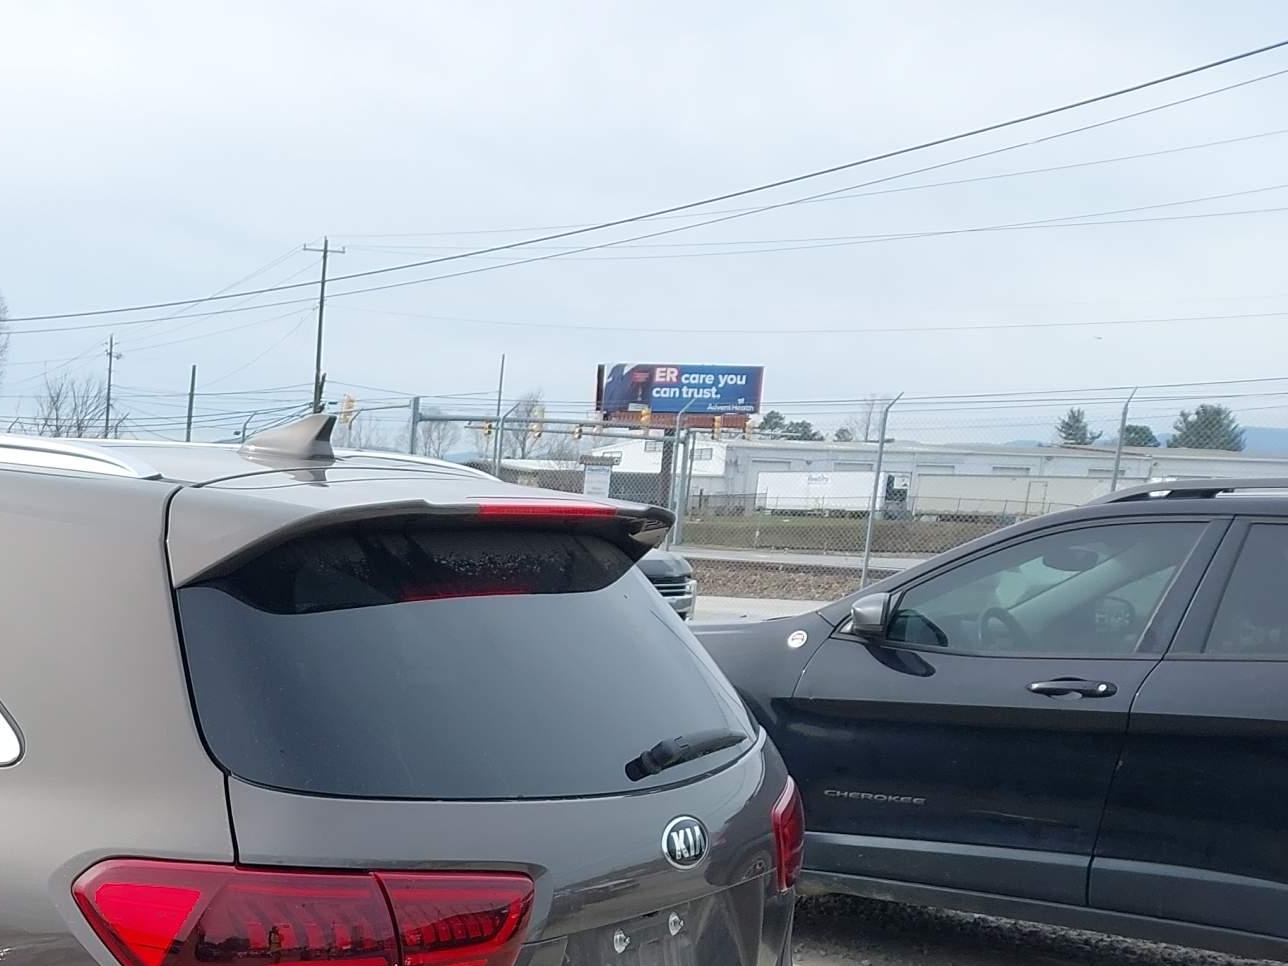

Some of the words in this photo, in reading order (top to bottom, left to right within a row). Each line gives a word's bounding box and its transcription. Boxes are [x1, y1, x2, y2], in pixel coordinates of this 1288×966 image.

[655, 367, 679, 382] ER
[681, 373, 714, 384] care
[718, 373, 747, 386] you
[652, 386, 679, 398] can
[681, 385, 721, 399] trust.
[823, 789, 926, 805] CHEROKEE
[671, 825, 705, 860] KIA
